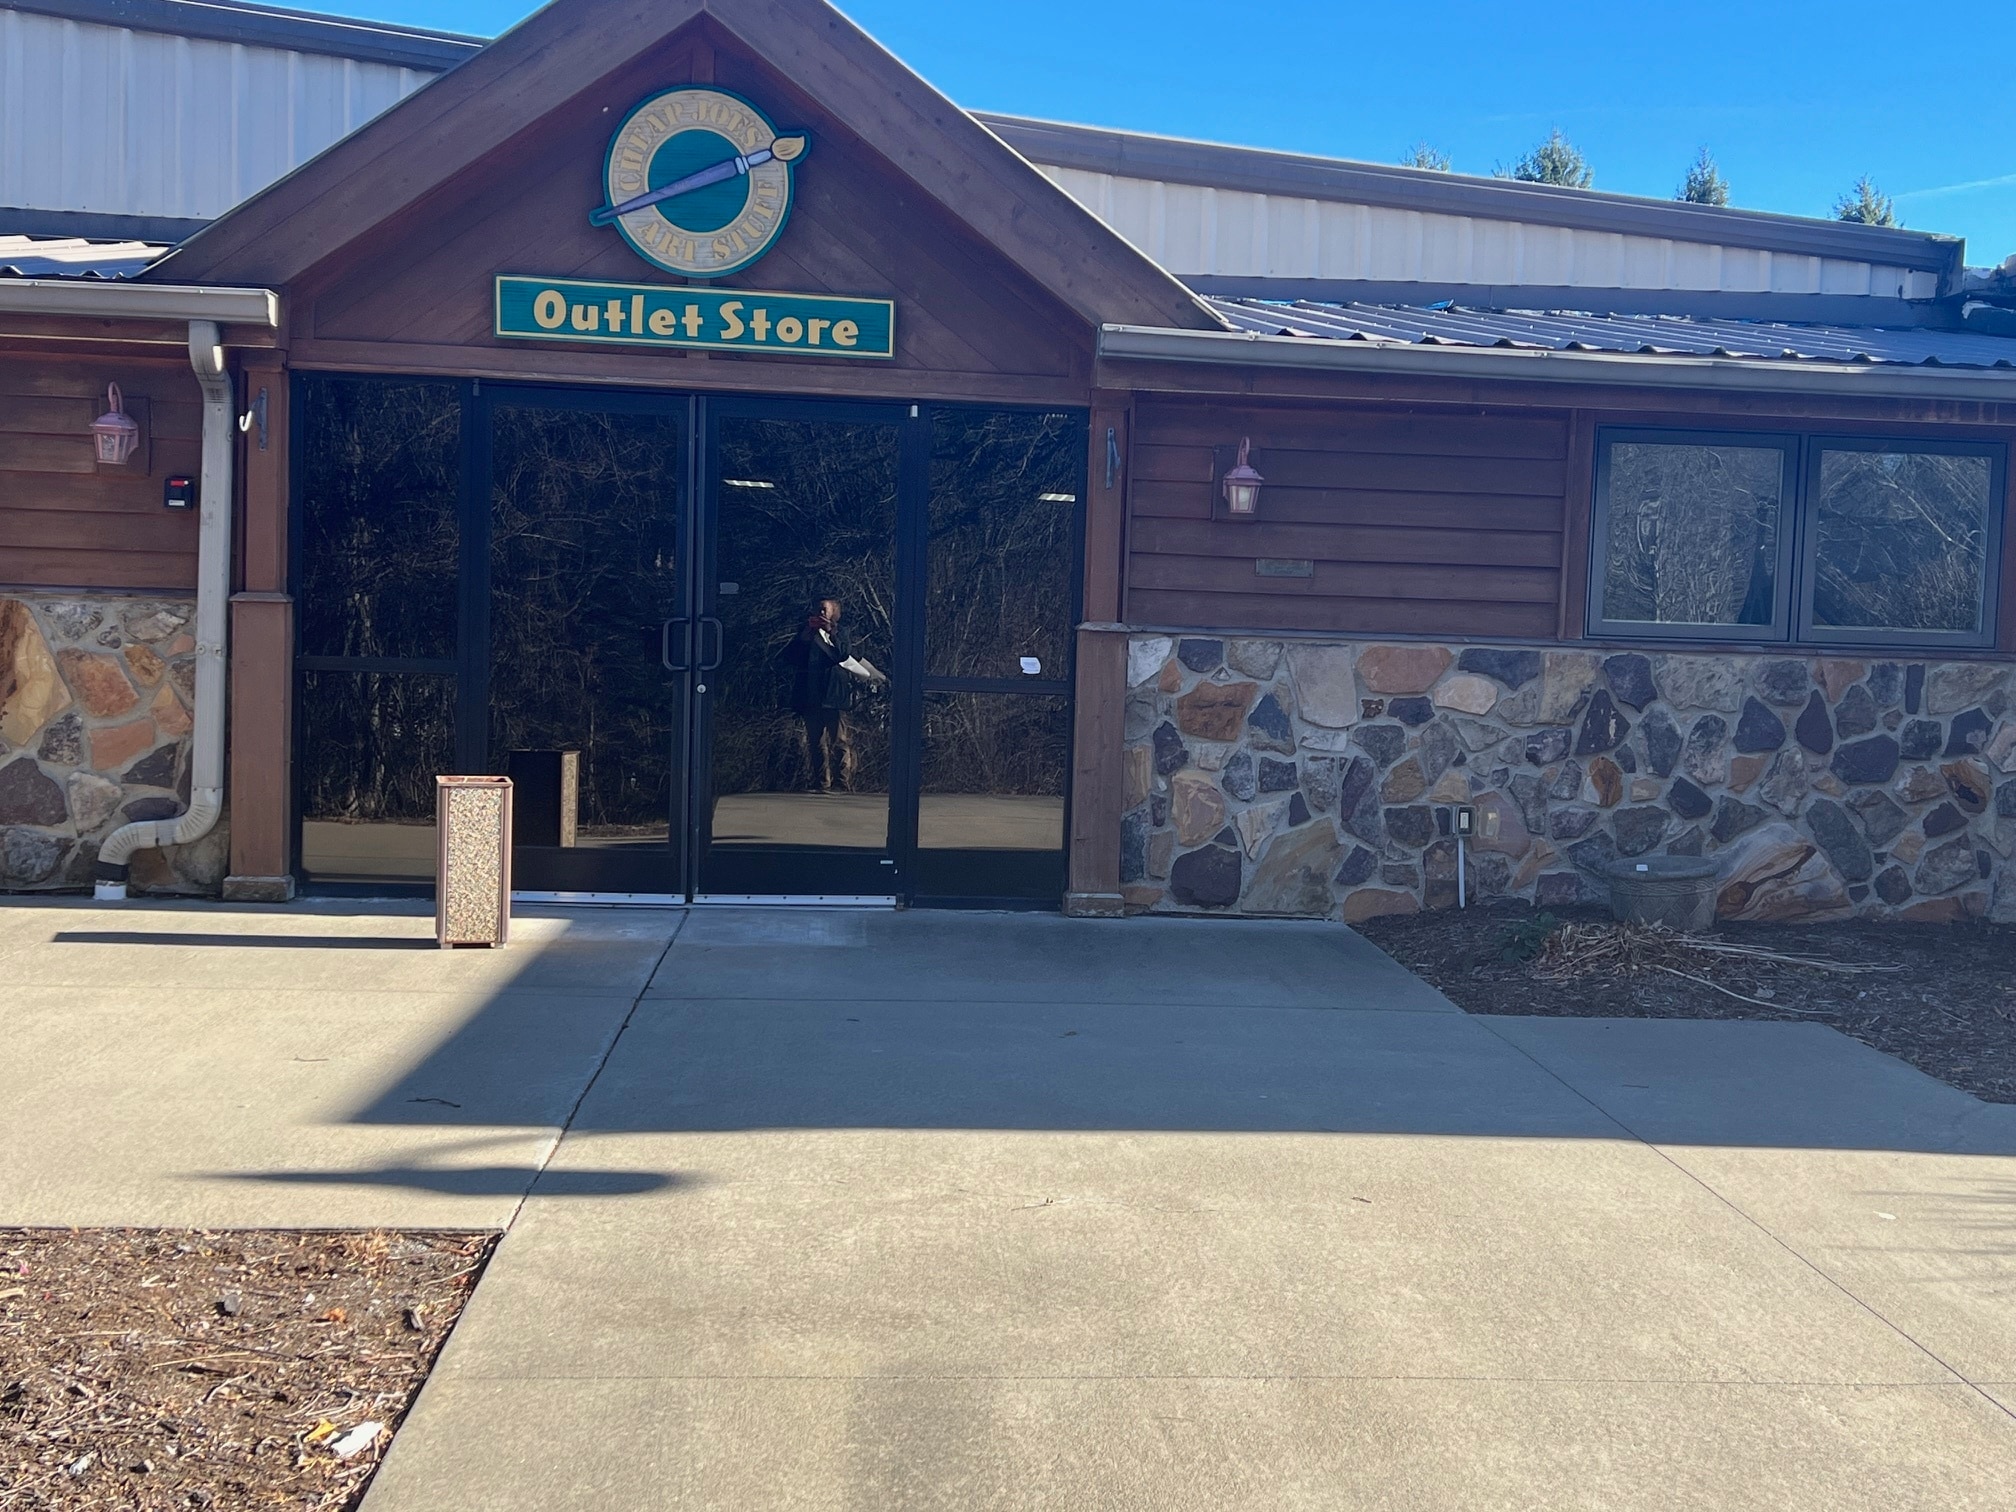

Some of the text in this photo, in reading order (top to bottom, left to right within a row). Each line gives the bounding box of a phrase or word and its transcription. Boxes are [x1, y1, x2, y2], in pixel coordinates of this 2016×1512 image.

[618, 103, 684, 191] CHEAP
[638, 179, 779, 261] ART STUFF
[533, 290, 859, 347] Outlet Store
